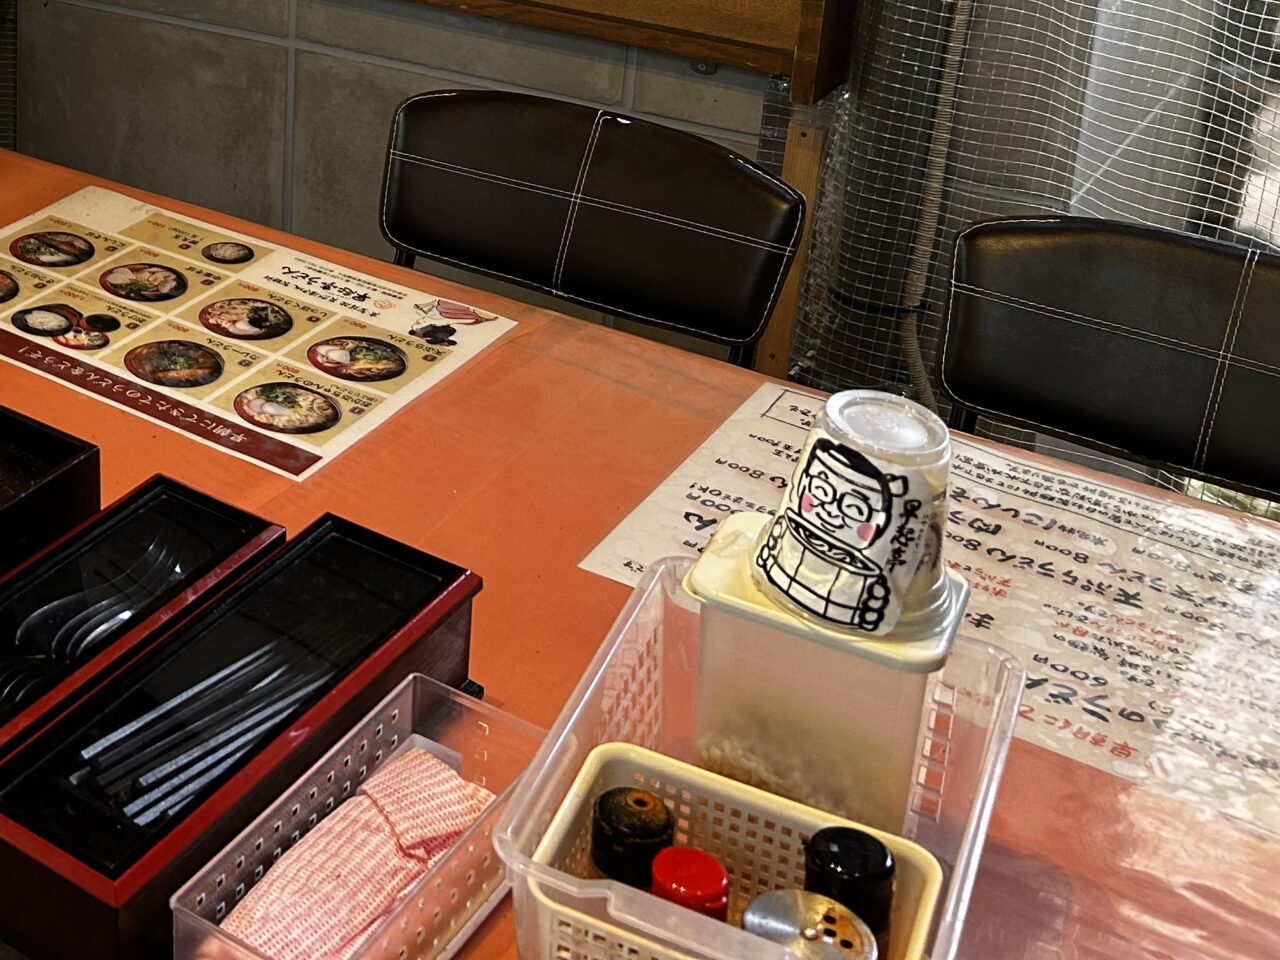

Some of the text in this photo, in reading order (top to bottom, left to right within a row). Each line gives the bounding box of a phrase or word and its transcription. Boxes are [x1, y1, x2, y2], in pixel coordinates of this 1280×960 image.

[273, 265, 374, 303] 早起亭うどん
[202, 337, 262, 361] カレーうどん
[710, 456, 766, 479] 800円
[886, 499, 922, 573] 早起亭
[1031, 539, 1090, 564] 800円
[979, 543, 1150, 610] 天ぷらうどん
[1029, 652, 1109, 690] 600円
